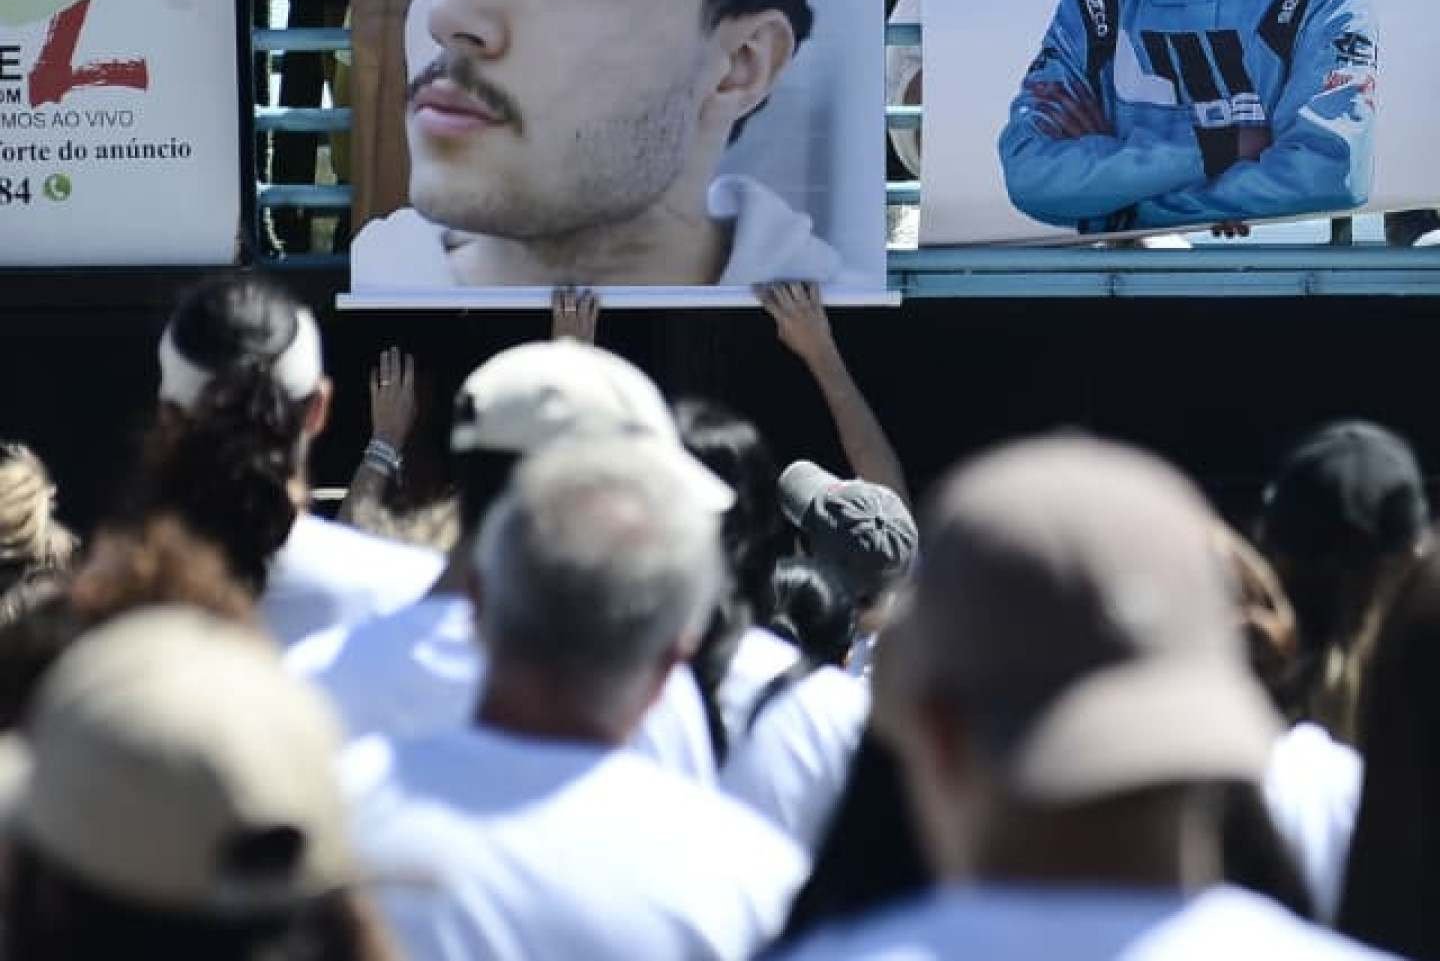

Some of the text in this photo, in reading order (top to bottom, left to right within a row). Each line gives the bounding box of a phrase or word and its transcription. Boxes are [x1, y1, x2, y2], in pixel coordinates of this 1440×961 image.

[52, 111, 80, 128] AO
[85, 110, 134, 127] VIVO
[58, 139, 87, 161] do
[95, 137, 192, 160] anúncio
